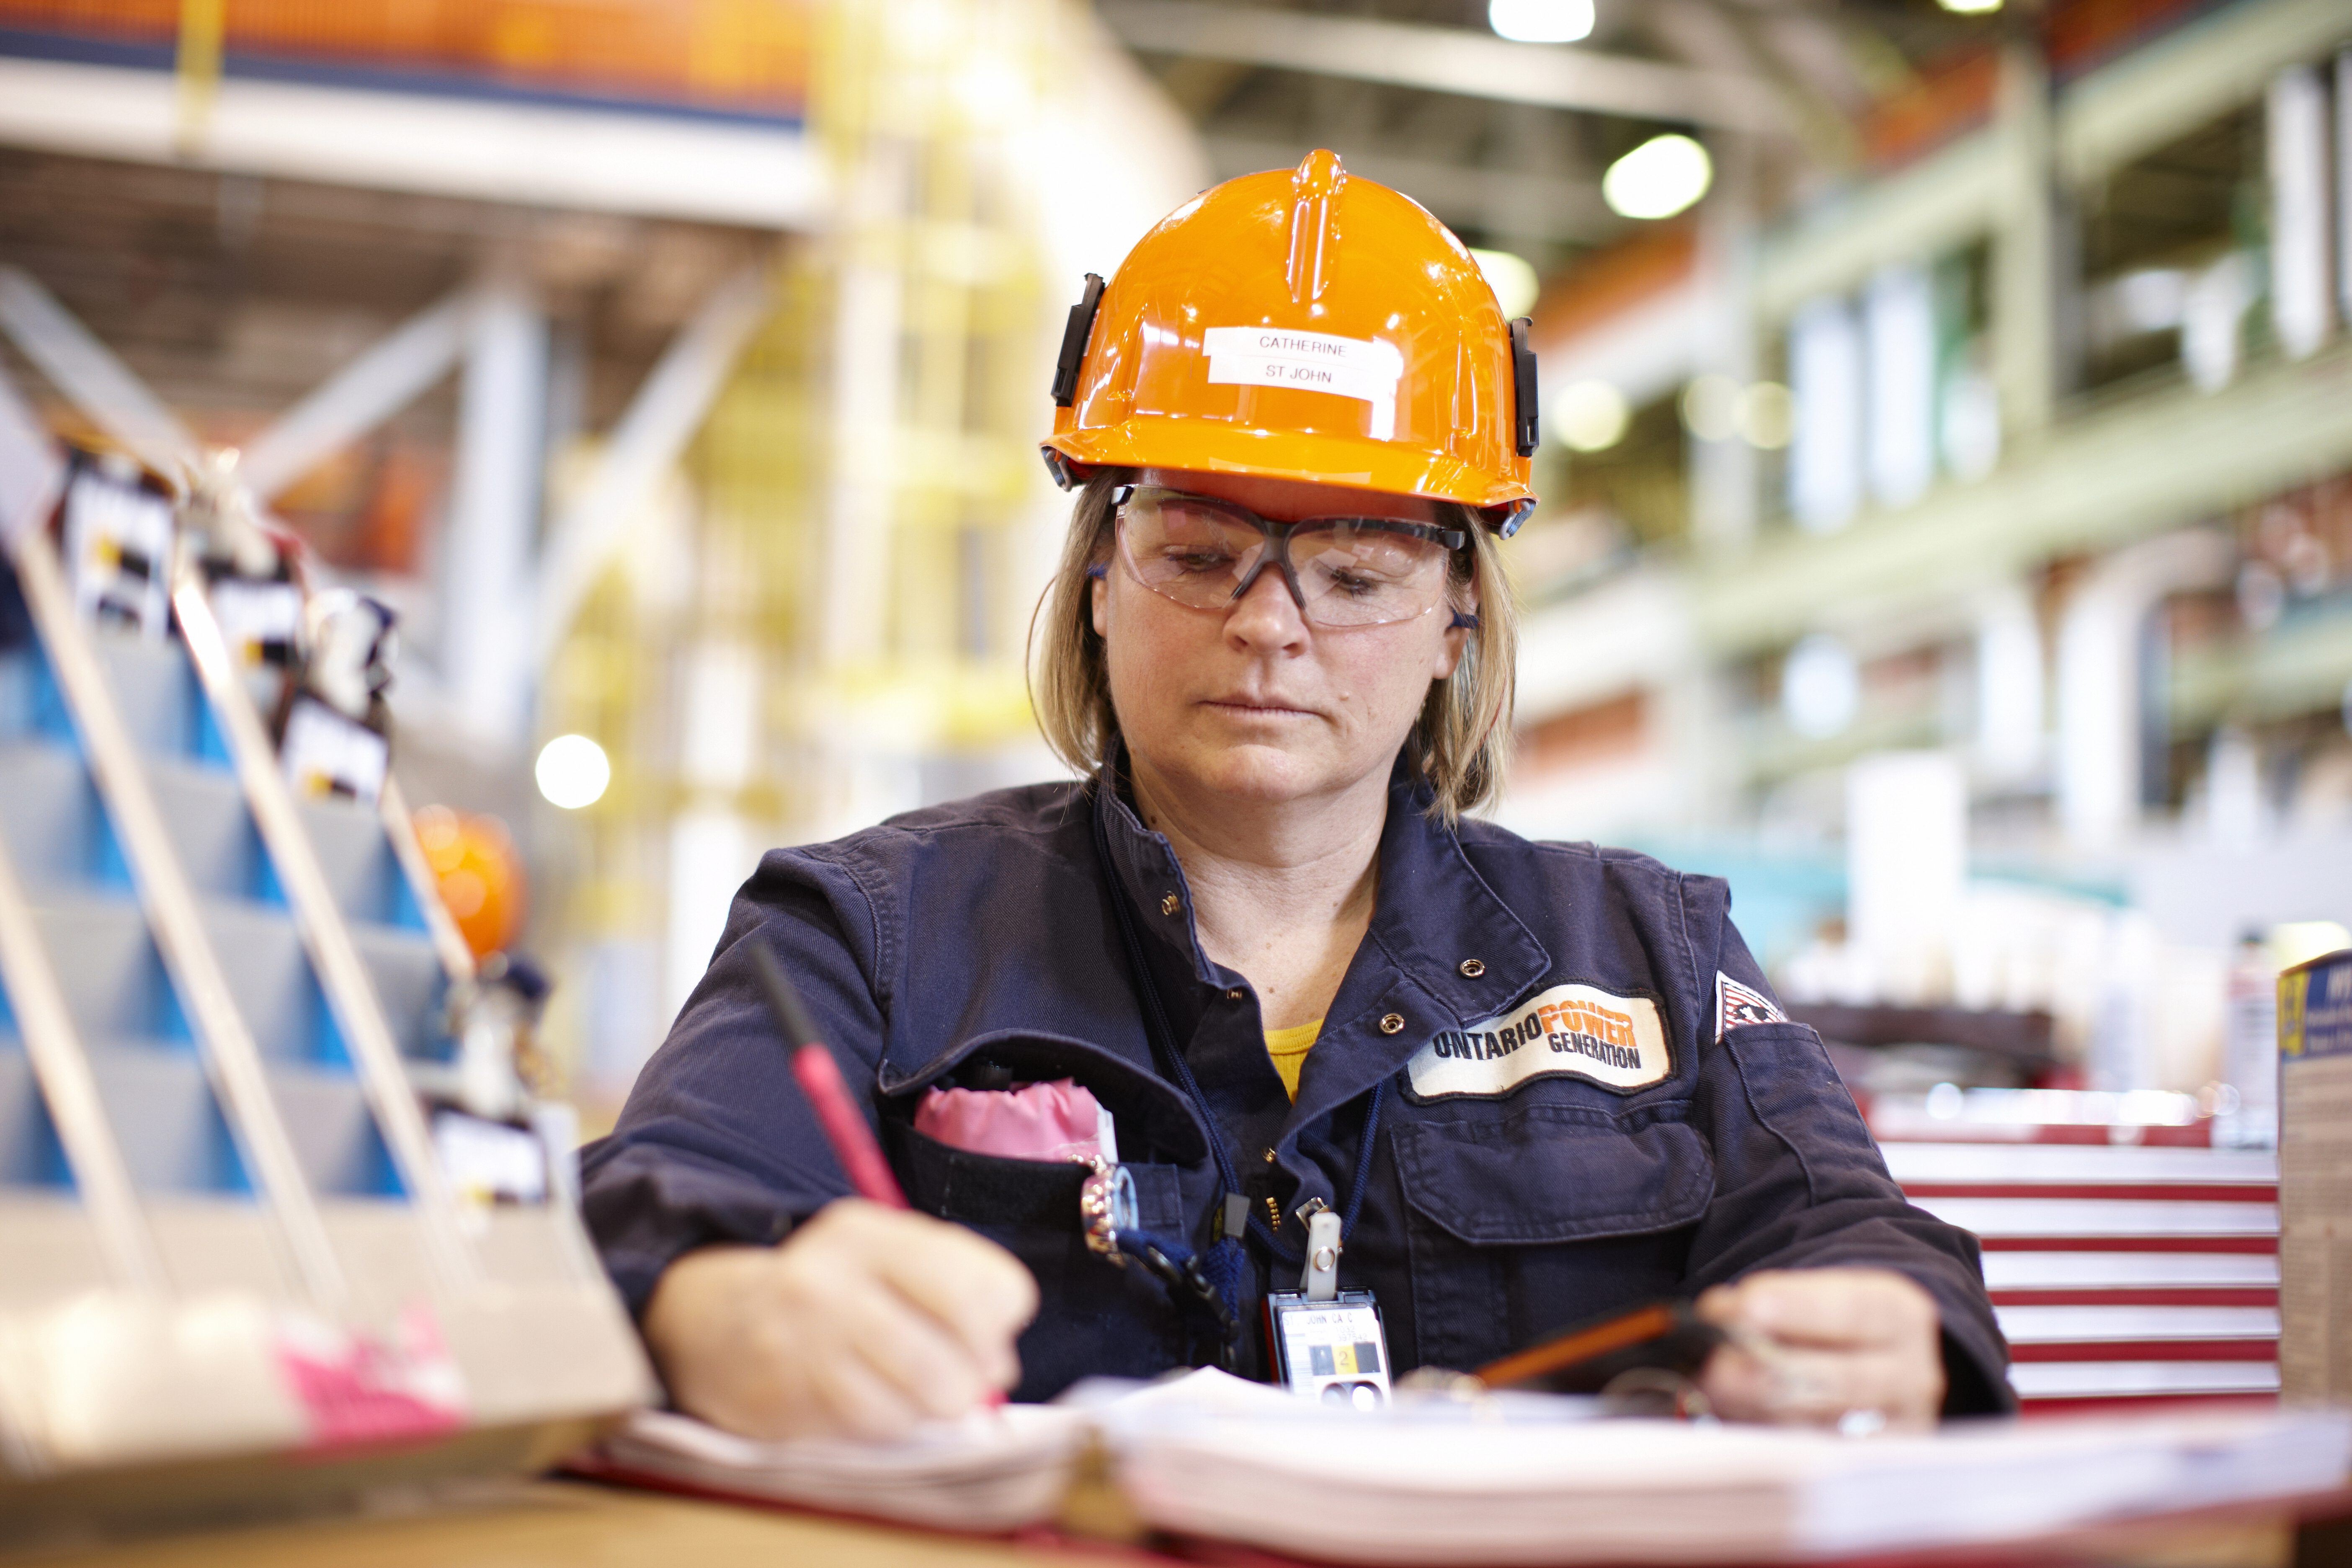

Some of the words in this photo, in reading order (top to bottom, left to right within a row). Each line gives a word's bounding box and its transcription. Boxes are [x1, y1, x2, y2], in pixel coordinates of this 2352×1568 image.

[1260, 336, 1347, 357] CATHERINE
[1266, 365, 1285, 377] ST
[1290, 368, 1332, 383] JOHN
[1434, 1013, 1542, 1060] ONTARIO
[1538, 1000, 1637, 1047] POWER
[1549, 1032, 1642, 1069] GENERATION
[1307, 1313, 1327, 1325] JOHN
[1339, 1351, 1349, 1366] 2
